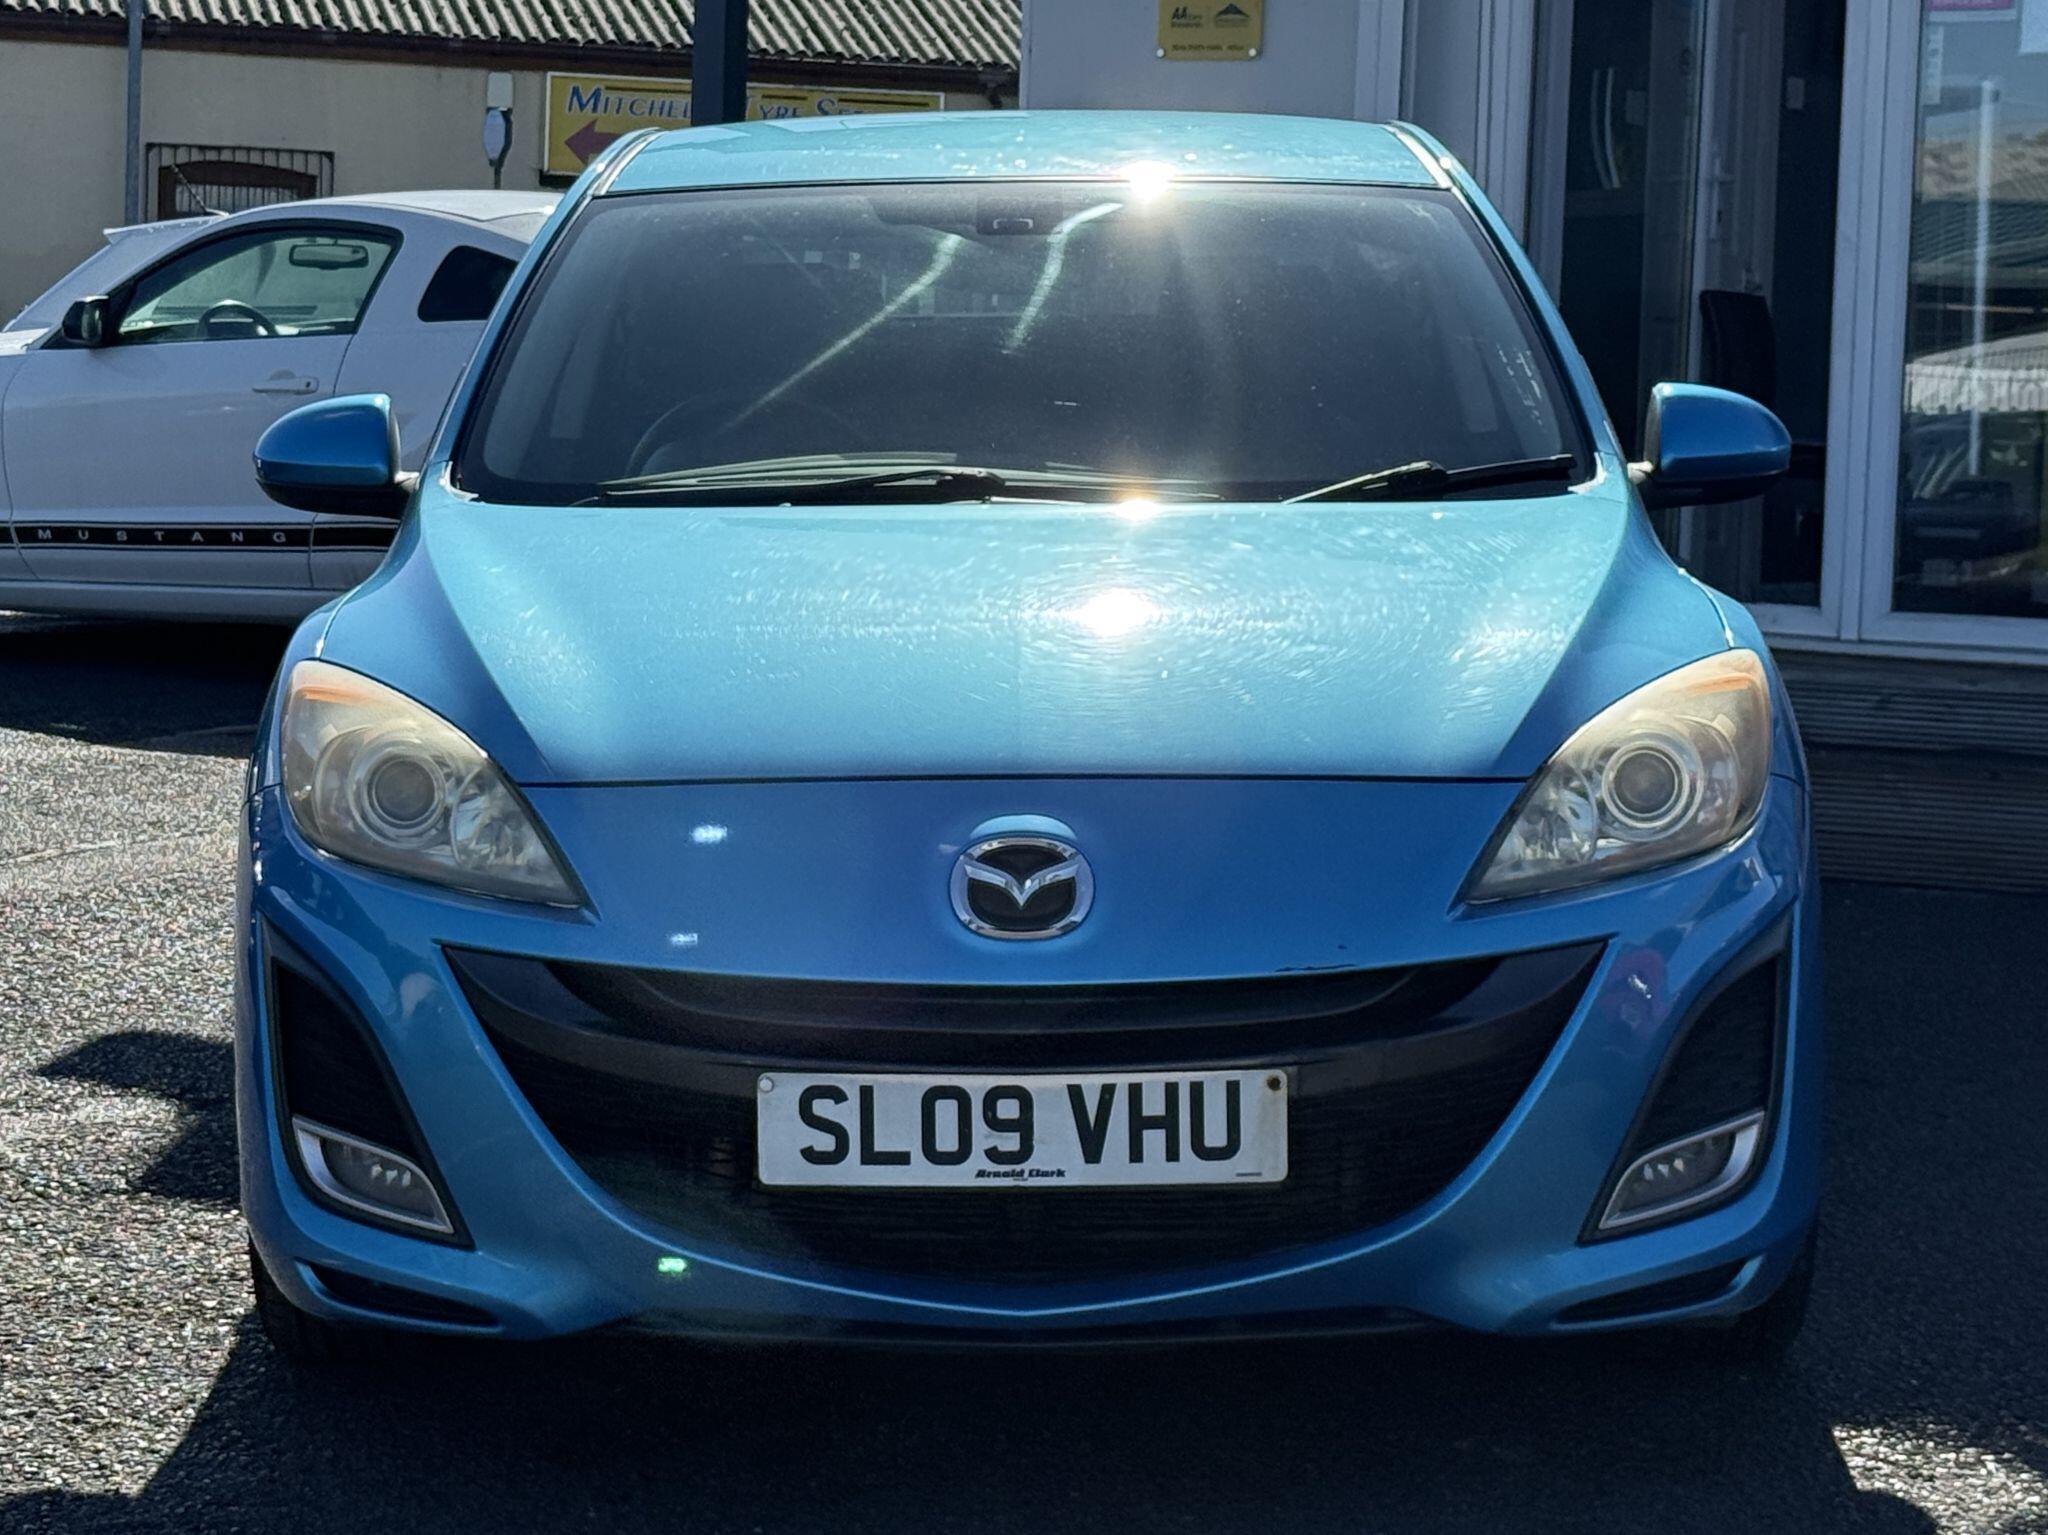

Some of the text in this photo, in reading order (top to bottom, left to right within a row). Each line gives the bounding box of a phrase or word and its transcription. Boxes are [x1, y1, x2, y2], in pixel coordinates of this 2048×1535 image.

[568, 85, 691, 119] MITCHEL
[37, 528, 287, 544] MUSTANG
[798, 1080, 1242, 1166] SL09 VHU
[1028, 1168, 1067, 1178] Clark
